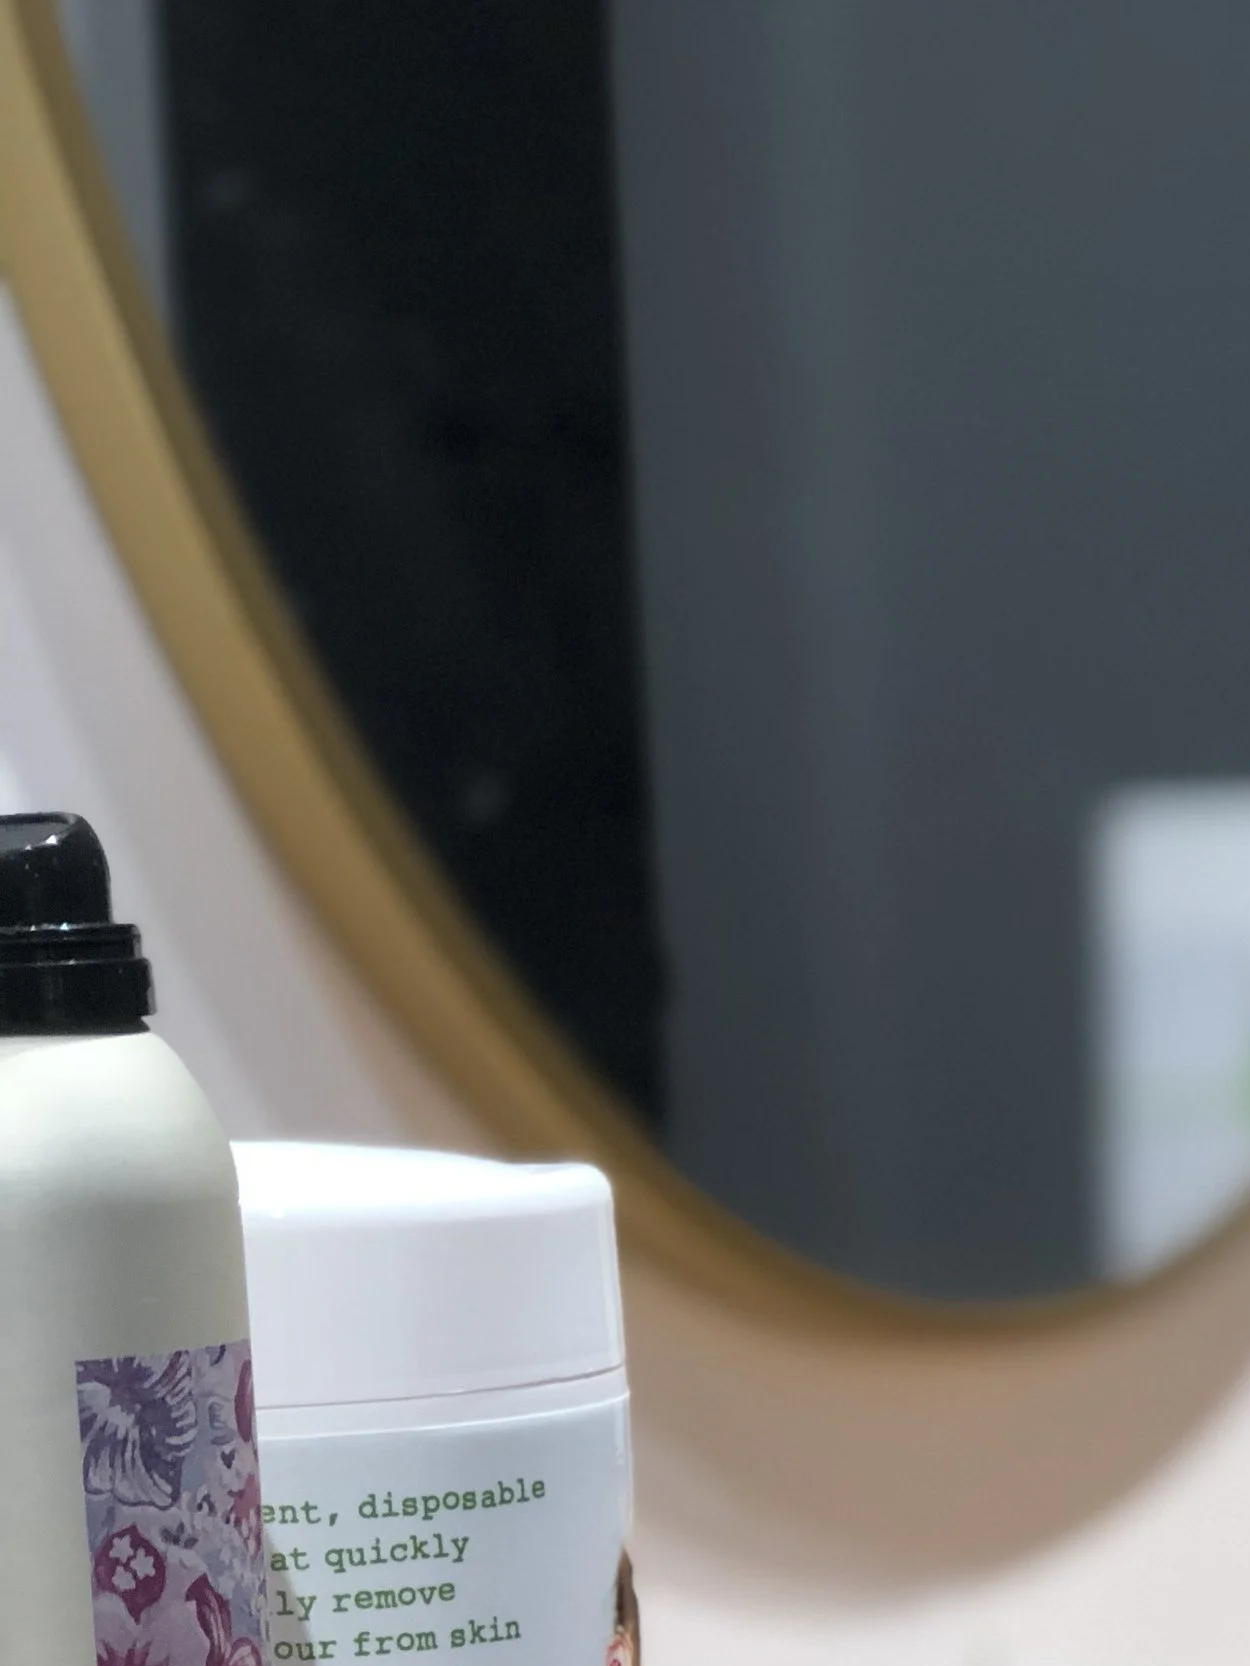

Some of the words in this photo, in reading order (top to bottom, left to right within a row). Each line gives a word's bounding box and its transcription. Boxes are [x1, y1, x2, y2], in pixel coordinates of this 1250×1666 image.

[358, 1478, 546, 1520] disposable
[270, 1547, 310, 1572] at
[325, 1533, 470, 1573] quickly
[276, 1591, 317, 1621] ly
[332, 1582, 455, 1612] remove
[274, 1639, 337, 1661] our
[353, 1629, 438, 1656] from
[450, 1616, 521, 1648] skin
